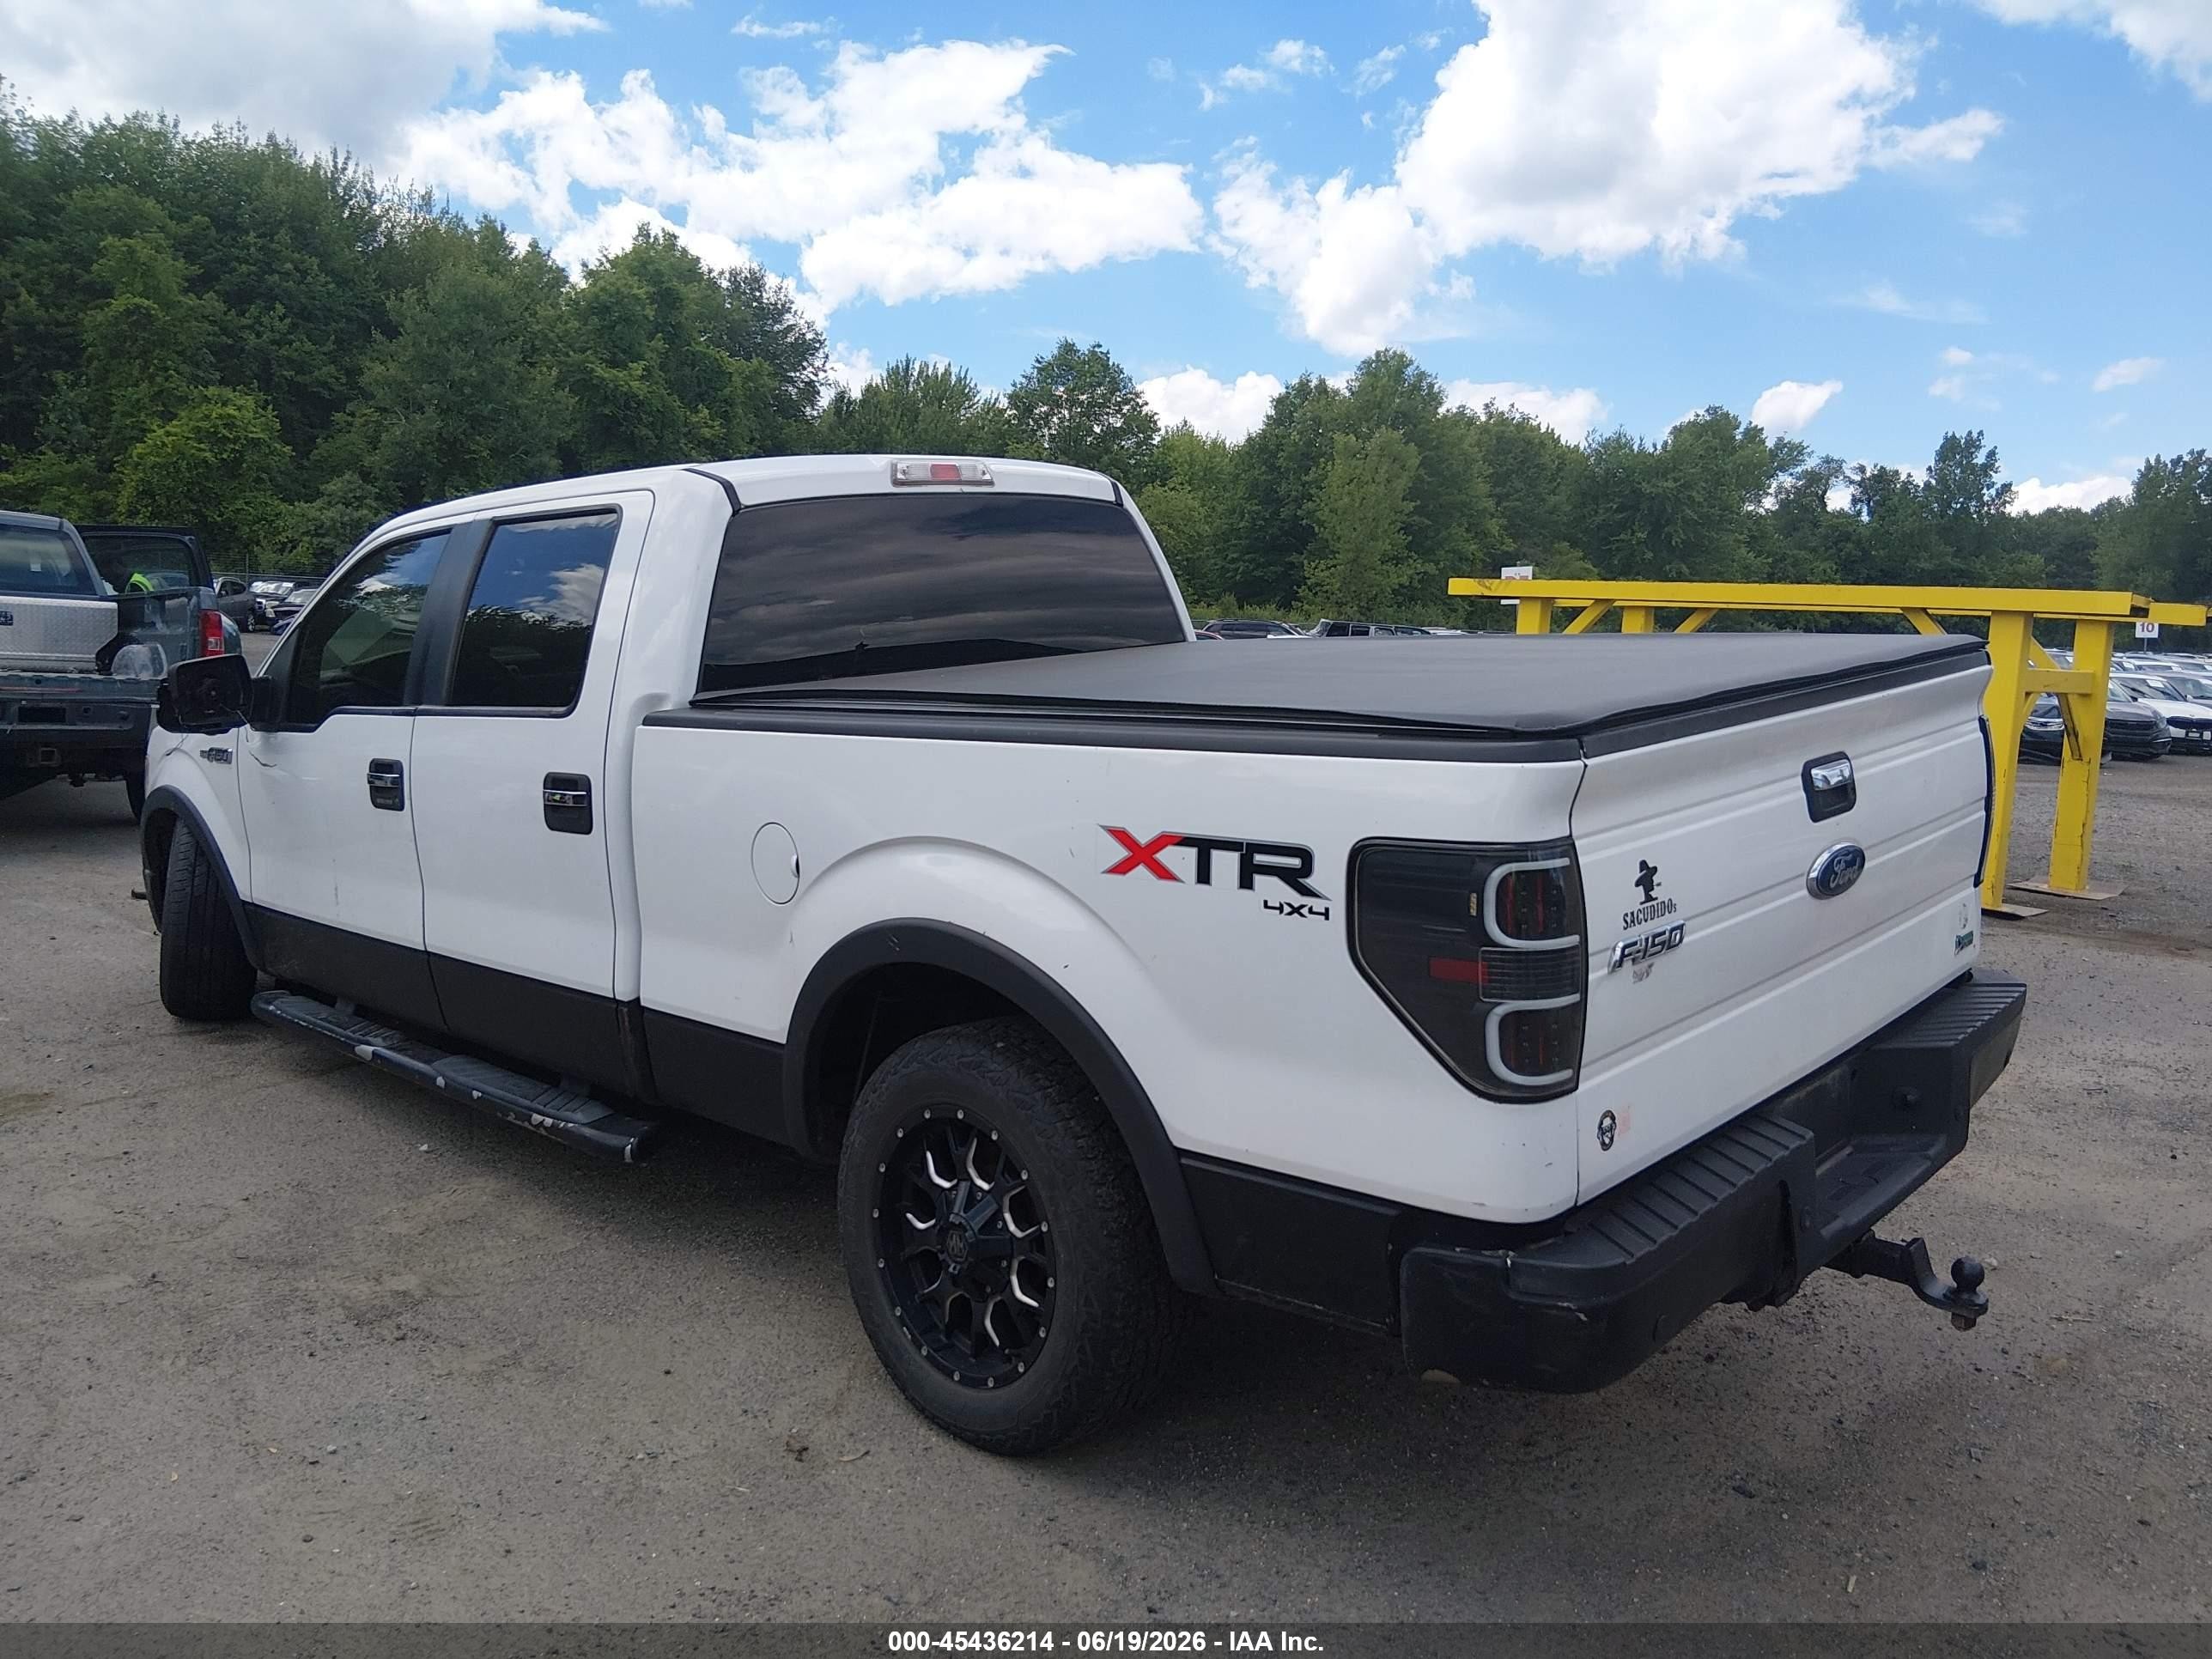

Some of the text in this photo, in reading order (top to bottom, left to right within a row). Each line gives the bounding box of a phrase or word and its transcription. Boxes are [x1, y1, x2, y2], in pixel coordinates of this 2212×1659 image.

[2139, 622, 2155, 633] 10
[1098, 824, 1333, 901] XTR
[1829, 850, 1862, 888] Ford
[1608, 921, 1686, 973] F-150
